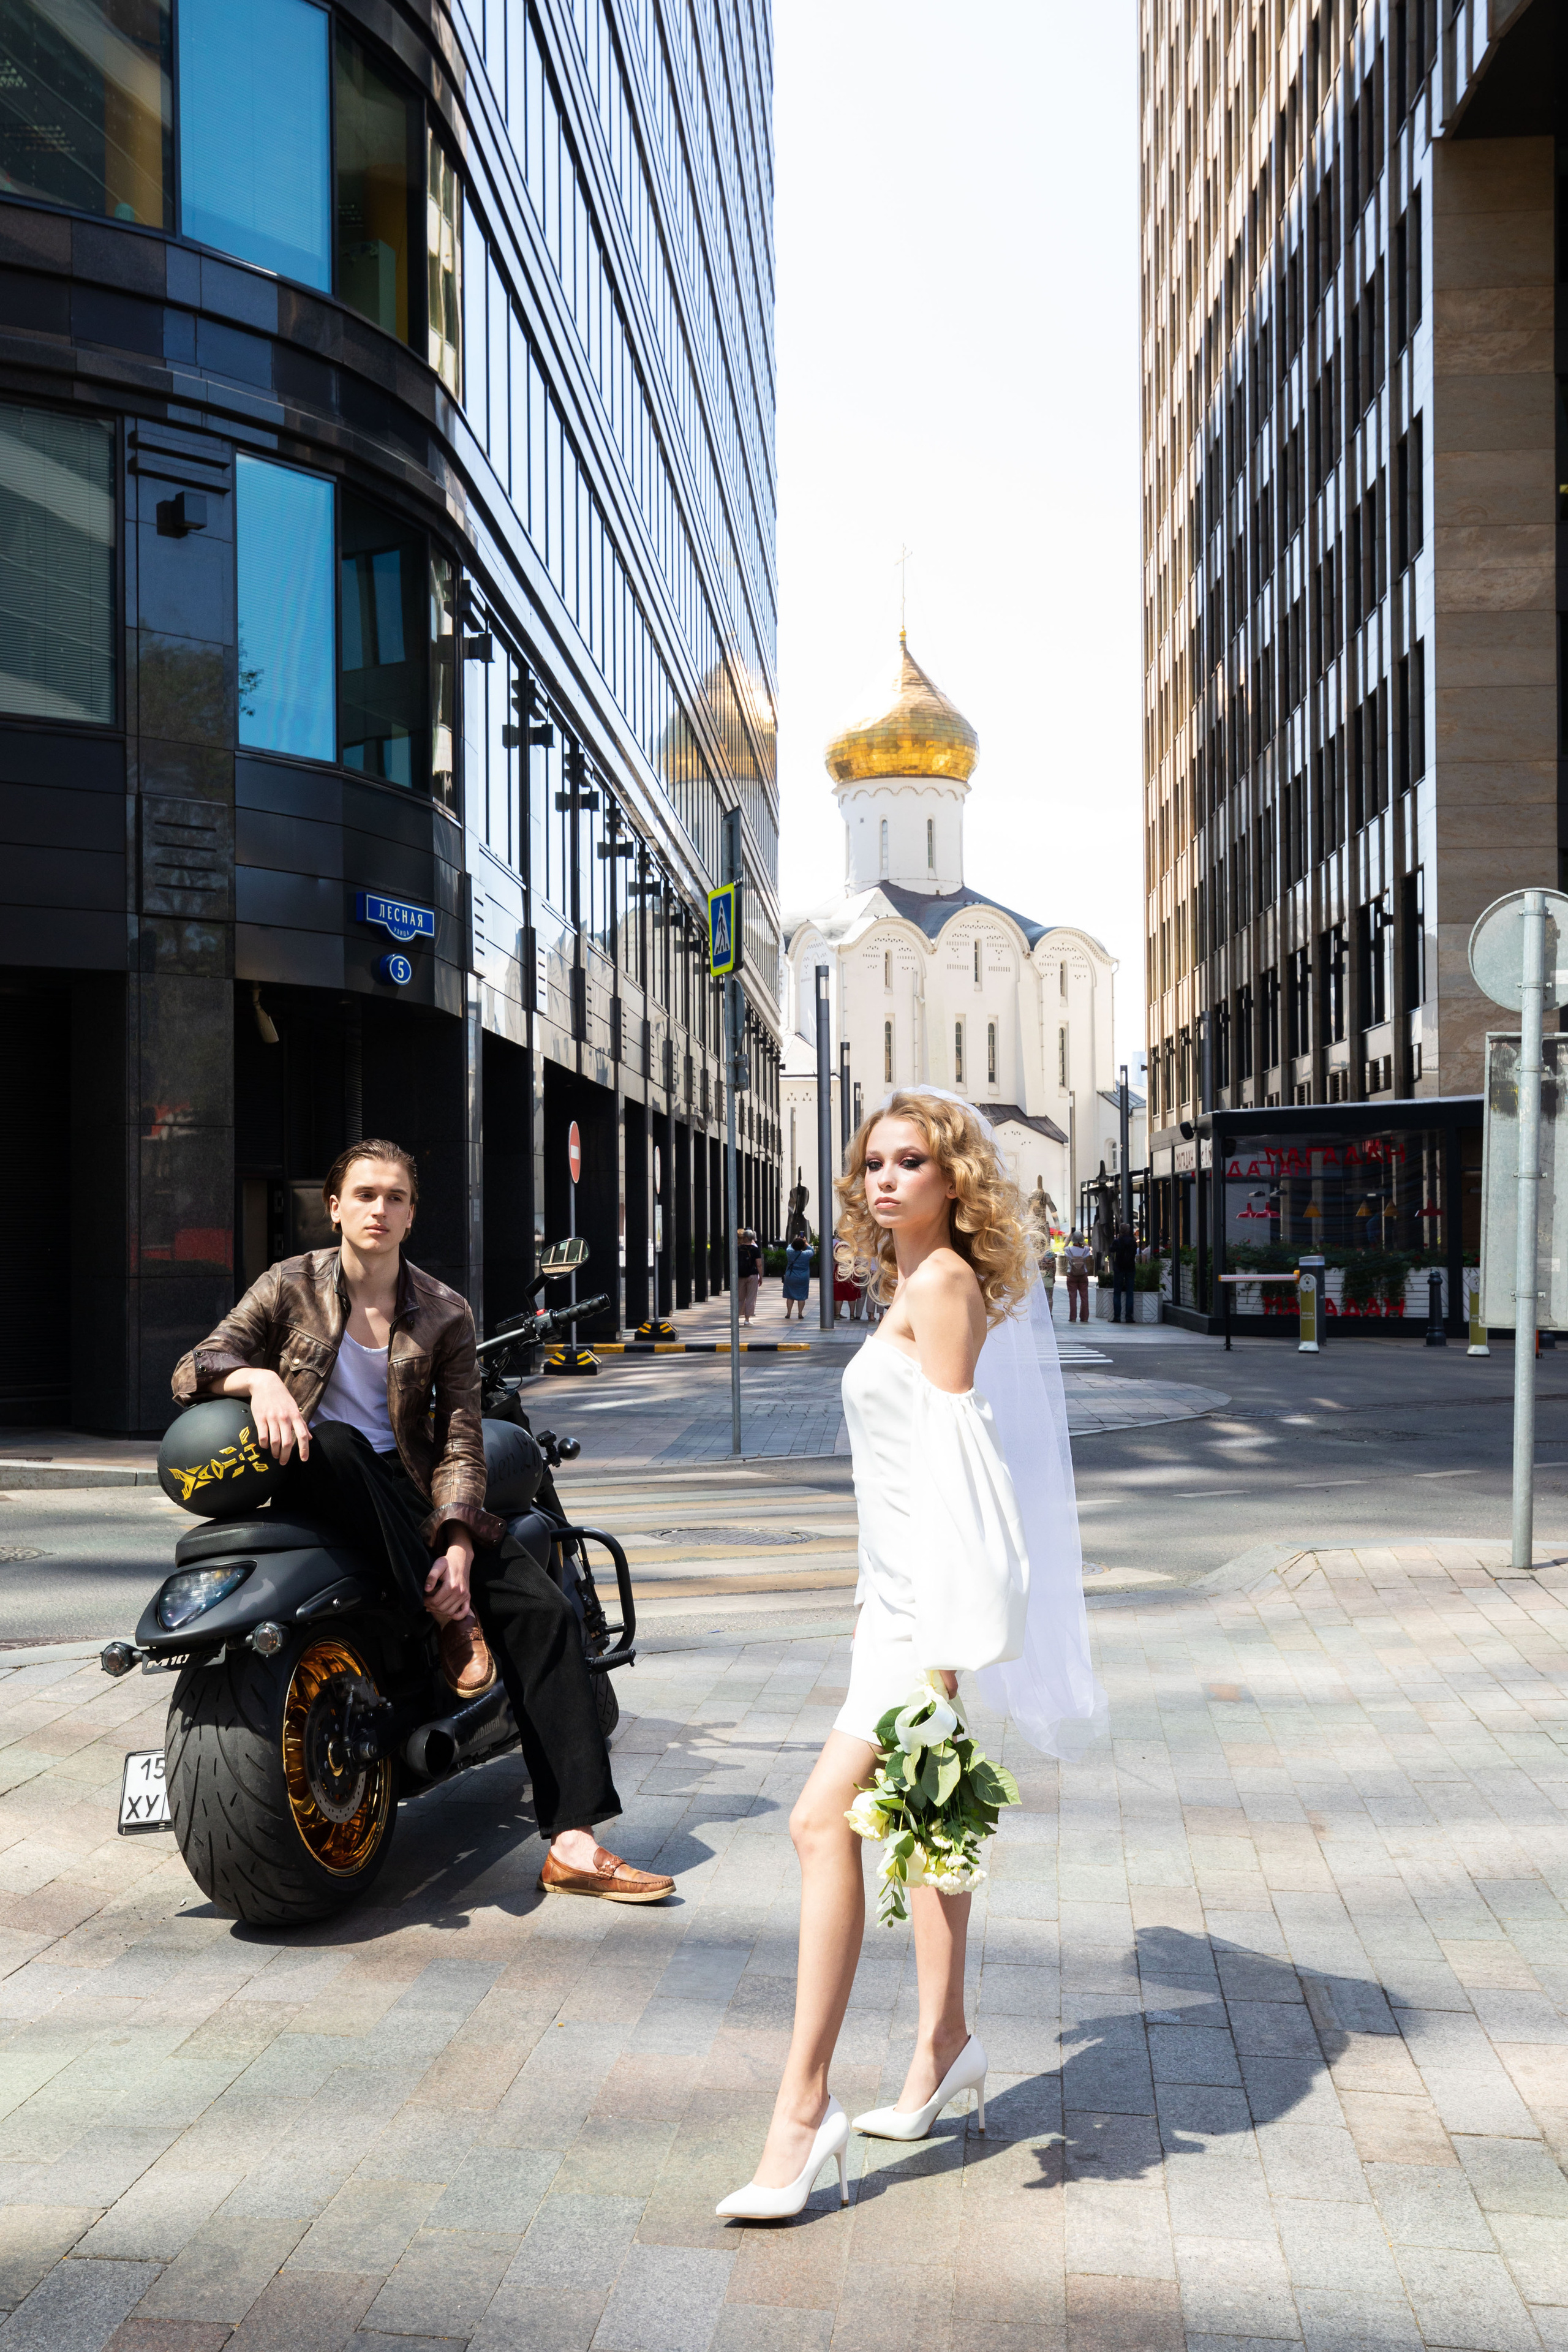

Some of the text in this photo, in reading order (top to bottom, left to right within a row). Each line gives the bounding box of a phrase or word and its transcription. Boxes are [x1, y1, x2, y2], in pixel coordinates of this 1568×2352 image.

[379, 904, 423, 927] ЛЕСНАЯ
[394, 927, 409, 937] УЛИЦА
[398, 960, 404, 979] 5
[1264, 1144, 1406, 1165] МАГАДАН
[1263, 1296, 1404, 1316] МААДАН
